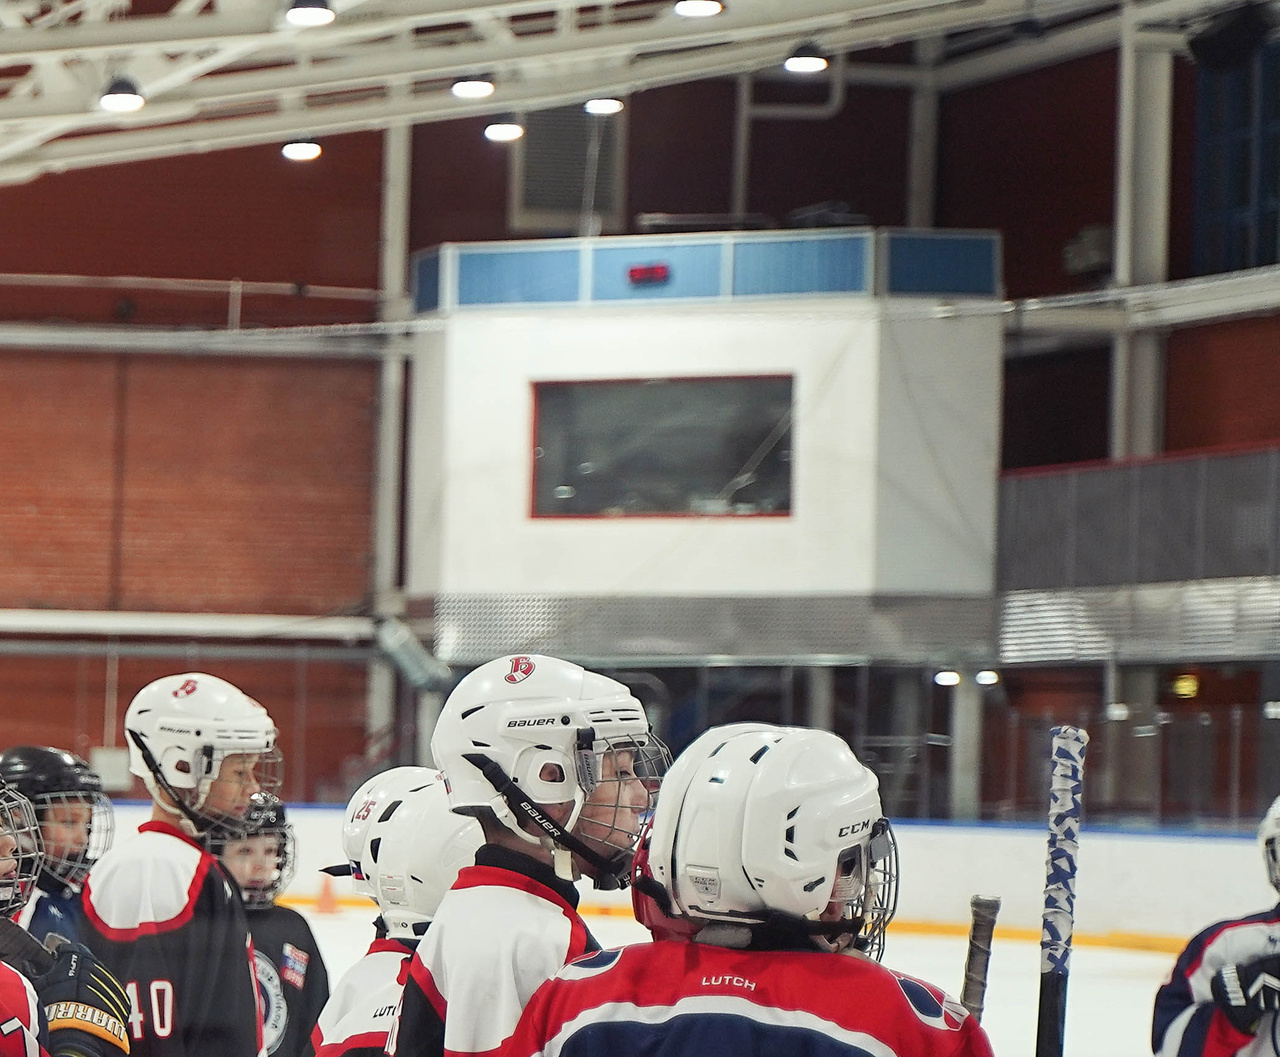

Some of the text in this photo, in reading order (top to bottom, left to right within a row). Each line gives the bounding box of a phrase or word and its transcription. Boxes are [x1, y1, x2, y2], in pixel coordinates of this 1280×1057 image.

[507, 718, 556, 728] BAUER
[355, 800, 377, 820] 25
[520, 801, 561, 838] BAUER
[838, 819, 871, 838] CCM
[701, 975, 756, 991] LUTCH
[45, 1002, 126, 1041] WARRI
